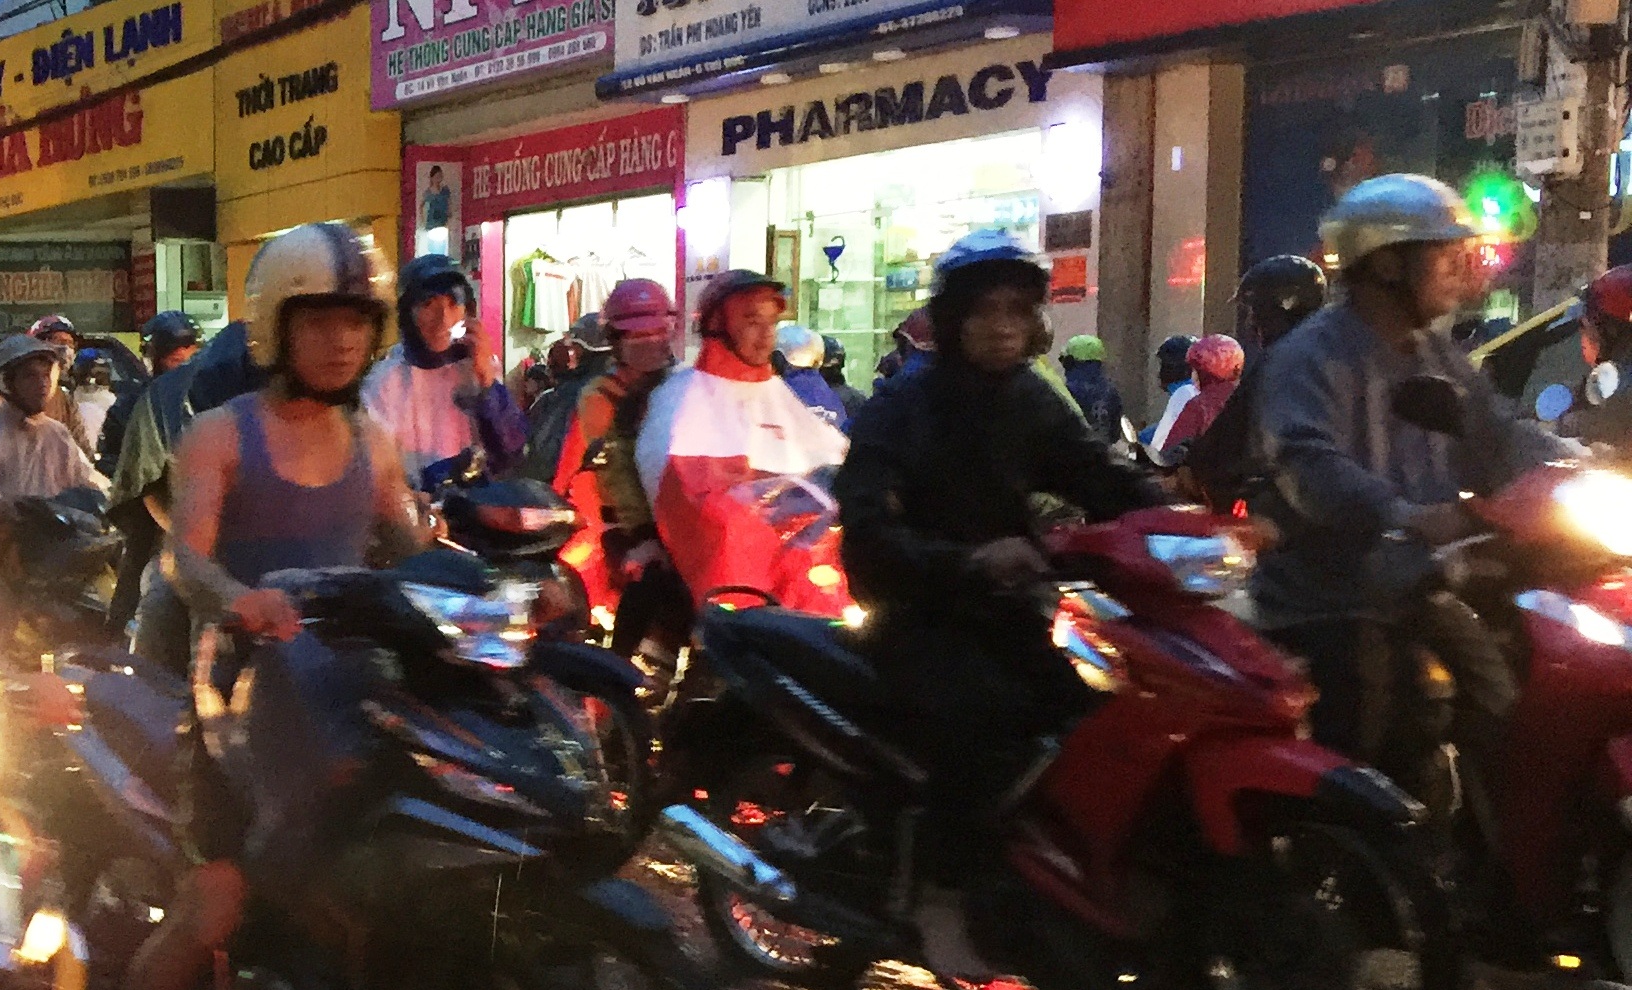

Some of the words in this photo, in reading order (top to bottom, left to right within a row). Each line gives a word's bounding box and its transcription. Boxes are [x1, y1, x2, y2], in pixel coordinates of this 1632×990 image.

[103, 2, 183, 68] LẠNH
[277, 60, 339, 106] TRANG
[721, 60, 1053, 156] PHARMACY
[249, 135, 286, 171] CAO
[289, 114, 328, 160] CẤP
[544, 148, 582, 188] CUNG
[667, 129, 677, 168] G
